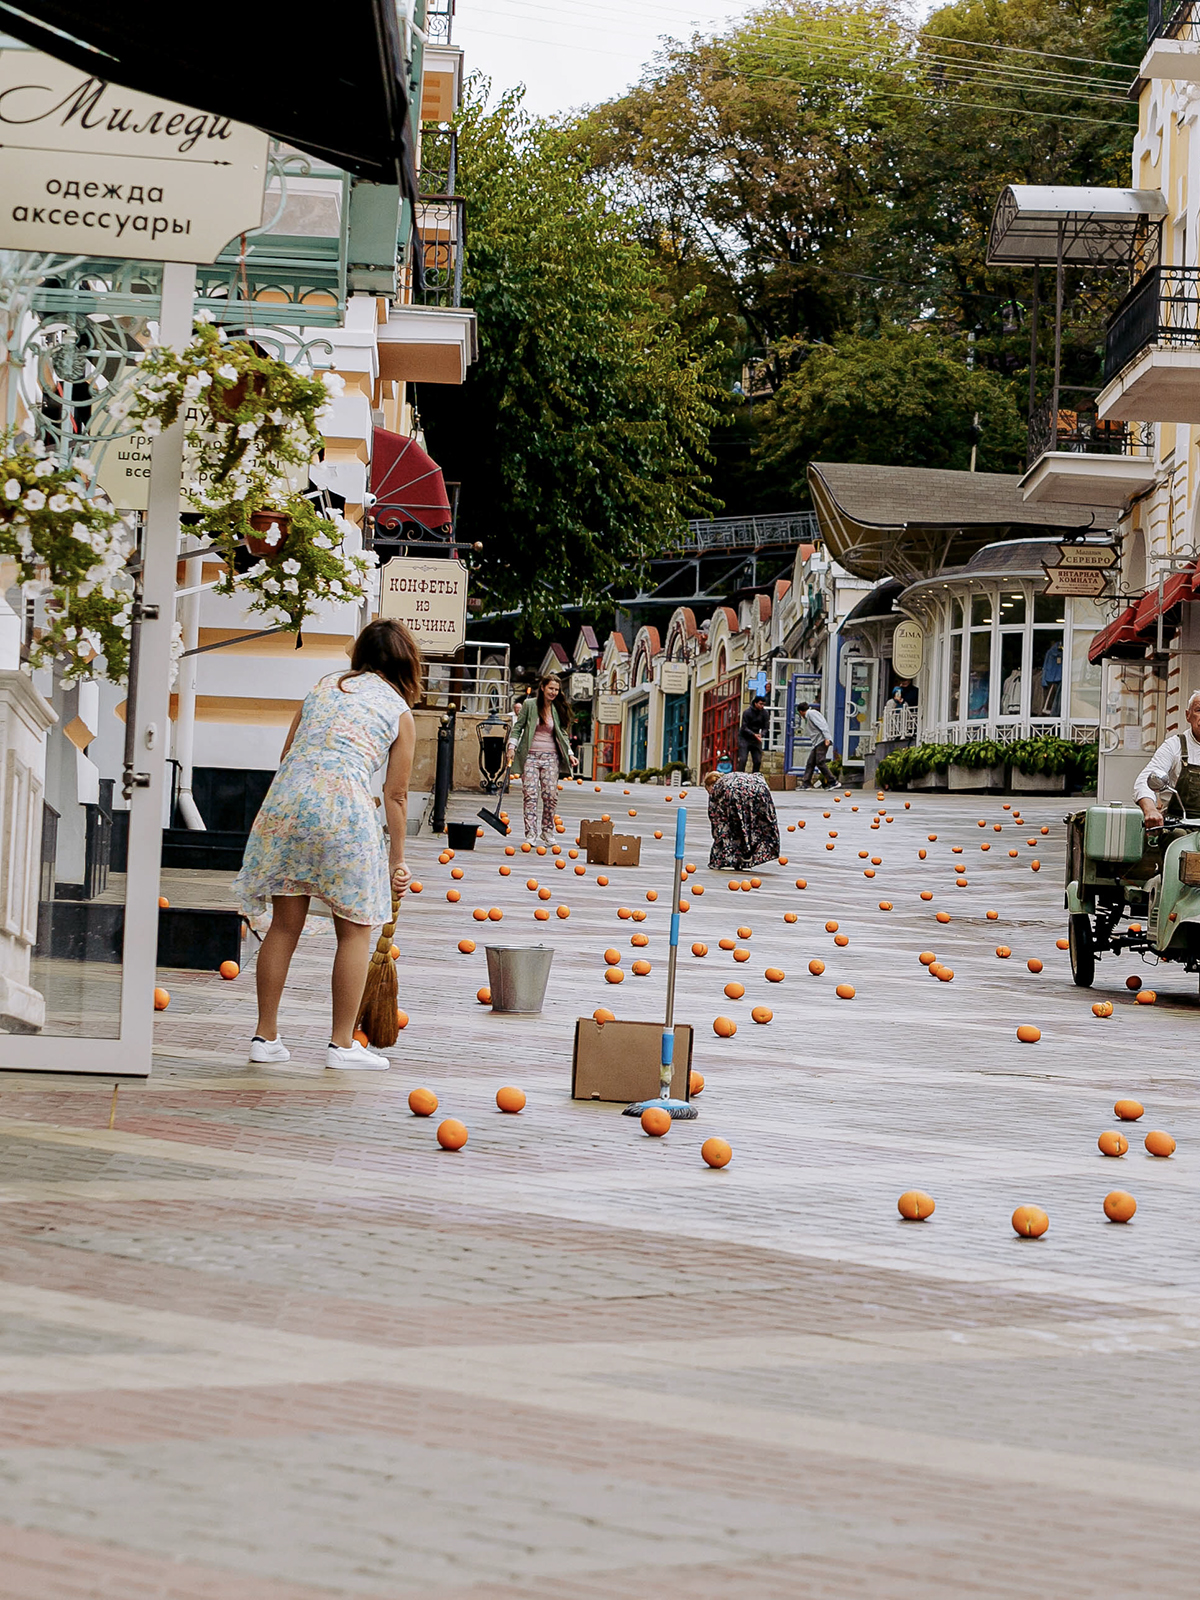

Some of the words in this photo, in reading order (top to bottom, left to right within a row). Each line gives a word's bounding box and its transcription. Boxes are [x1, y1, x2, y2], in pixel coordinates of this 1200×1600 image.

[0, 76, 233, 152] Миледи
[46, 178, 164, 204] одежда
[12, 204, 192, 240] аксессуары
[1065, 556, 1111, 564] СЕРЕБРО
[1057, 570, 1100, 578] ЯНТАРНАЯ
[389, 577, 459, 595] КОНФЕТЫ
[416, 600, 431, 612] ИЗ
